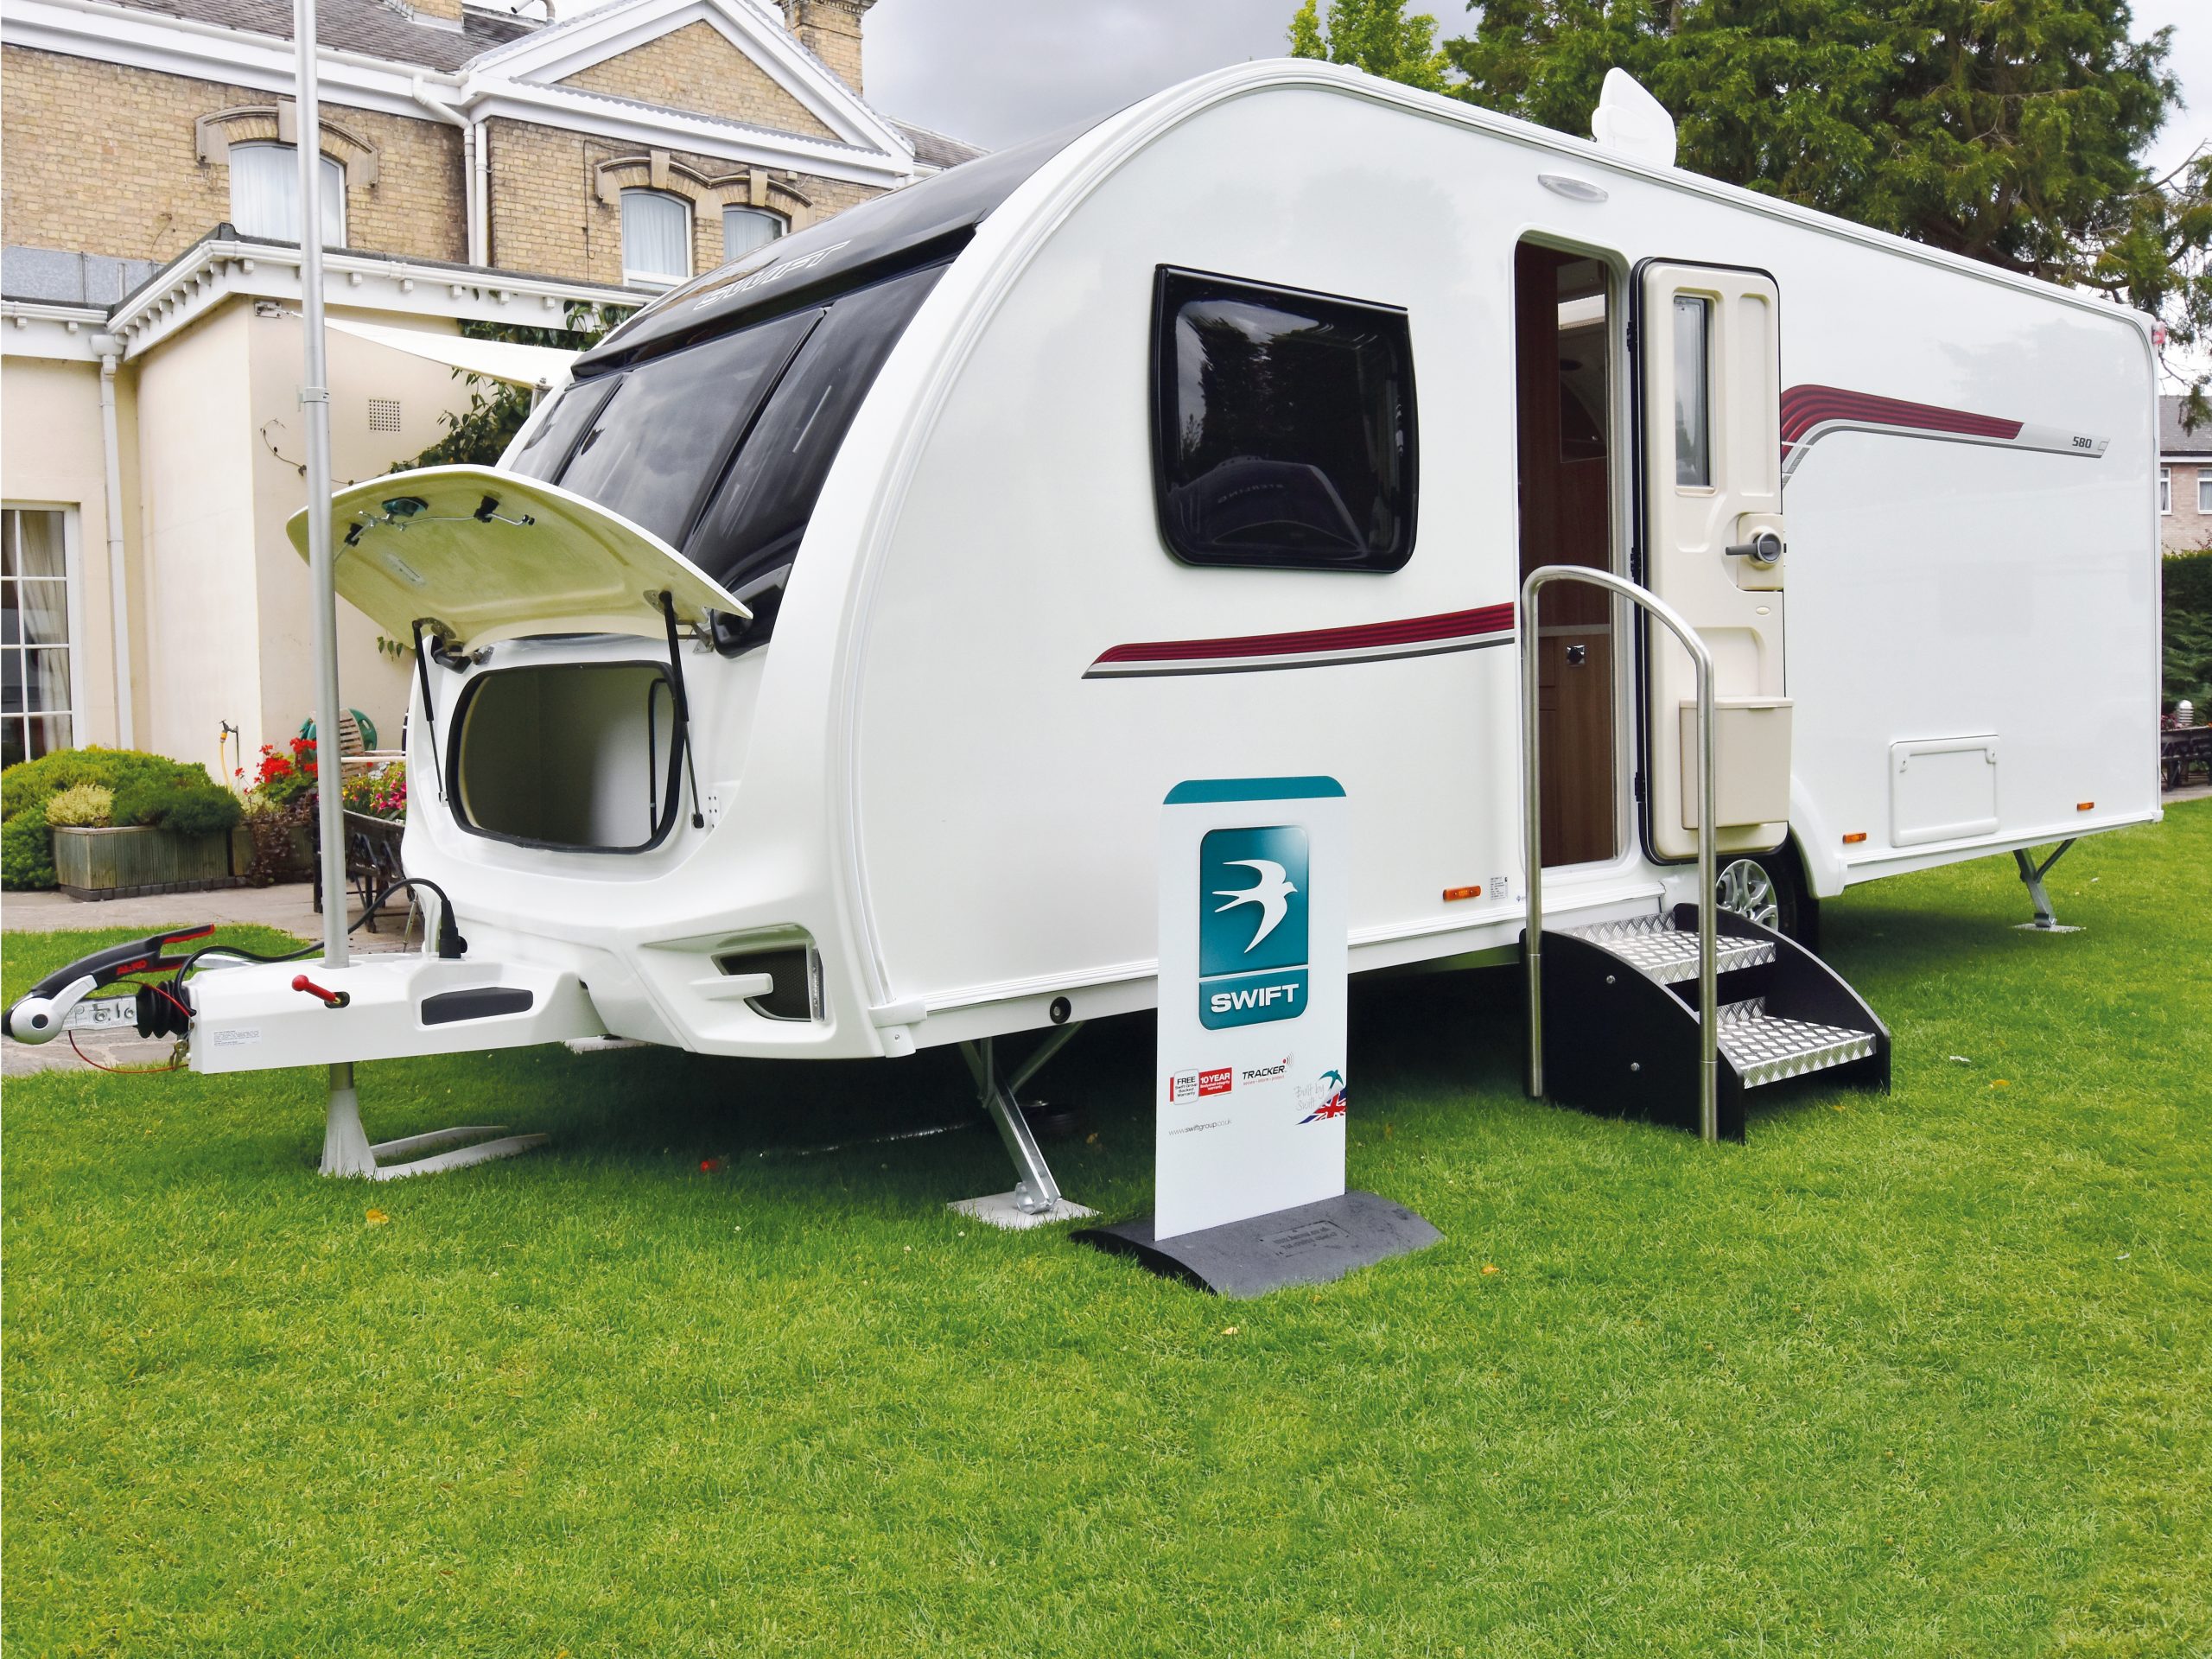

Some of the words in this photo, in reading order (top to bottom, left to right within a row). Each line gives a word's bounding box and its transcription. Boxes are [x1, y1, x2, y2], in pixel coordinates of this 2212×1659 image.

[693, 239, 851, 310] SWIFT
[2072, 436, 2092, 448] 580
[1211, 983, 1300, 1013] SWIFT
[1200, 1076, 1209, 1084] 10
[1209, 1072, 1230, 1083] YEAR
[1243, 1065, 1285, 1080] TRACKER
[1177, 1076, 1196, 1085] FREE
[1315, 1083, 1325, 1100] by
[1296, 1096, 1315, 1111] Swift
[1168, 1118, 1231, 1135] www.swiftgroup.co.uk
